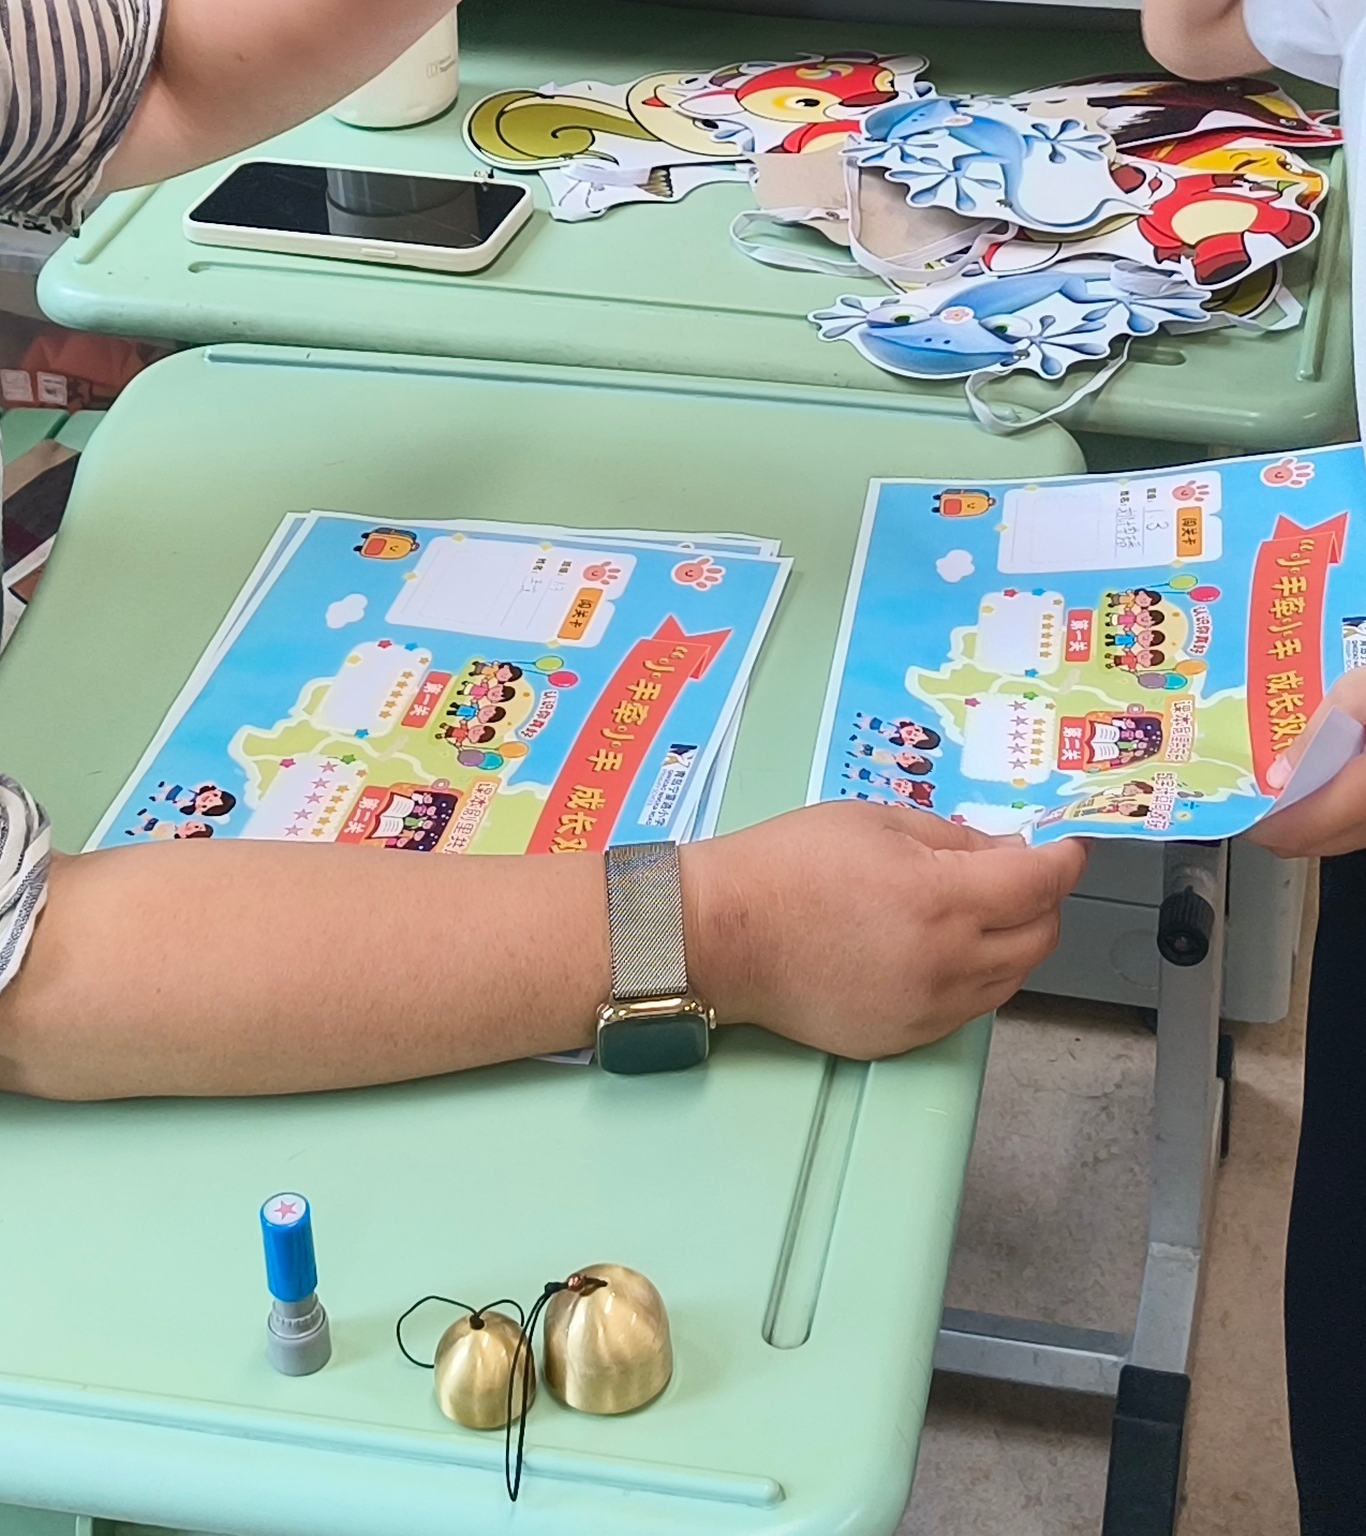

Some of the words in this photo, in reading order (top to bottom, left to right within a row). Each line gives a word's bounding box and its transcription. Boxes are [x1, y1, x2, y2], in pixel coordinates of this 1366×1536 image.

[1068, 619, 1089, 652] 第一关
[1190, 605, 1212, 654] 认识你真好
[408, 681, 443, 717] 第一关
[520, 690, 558, 740] 认识你真好
[1060, 726, 1082, 760] 第二关
[343, 797, 380, 834] 第二关
